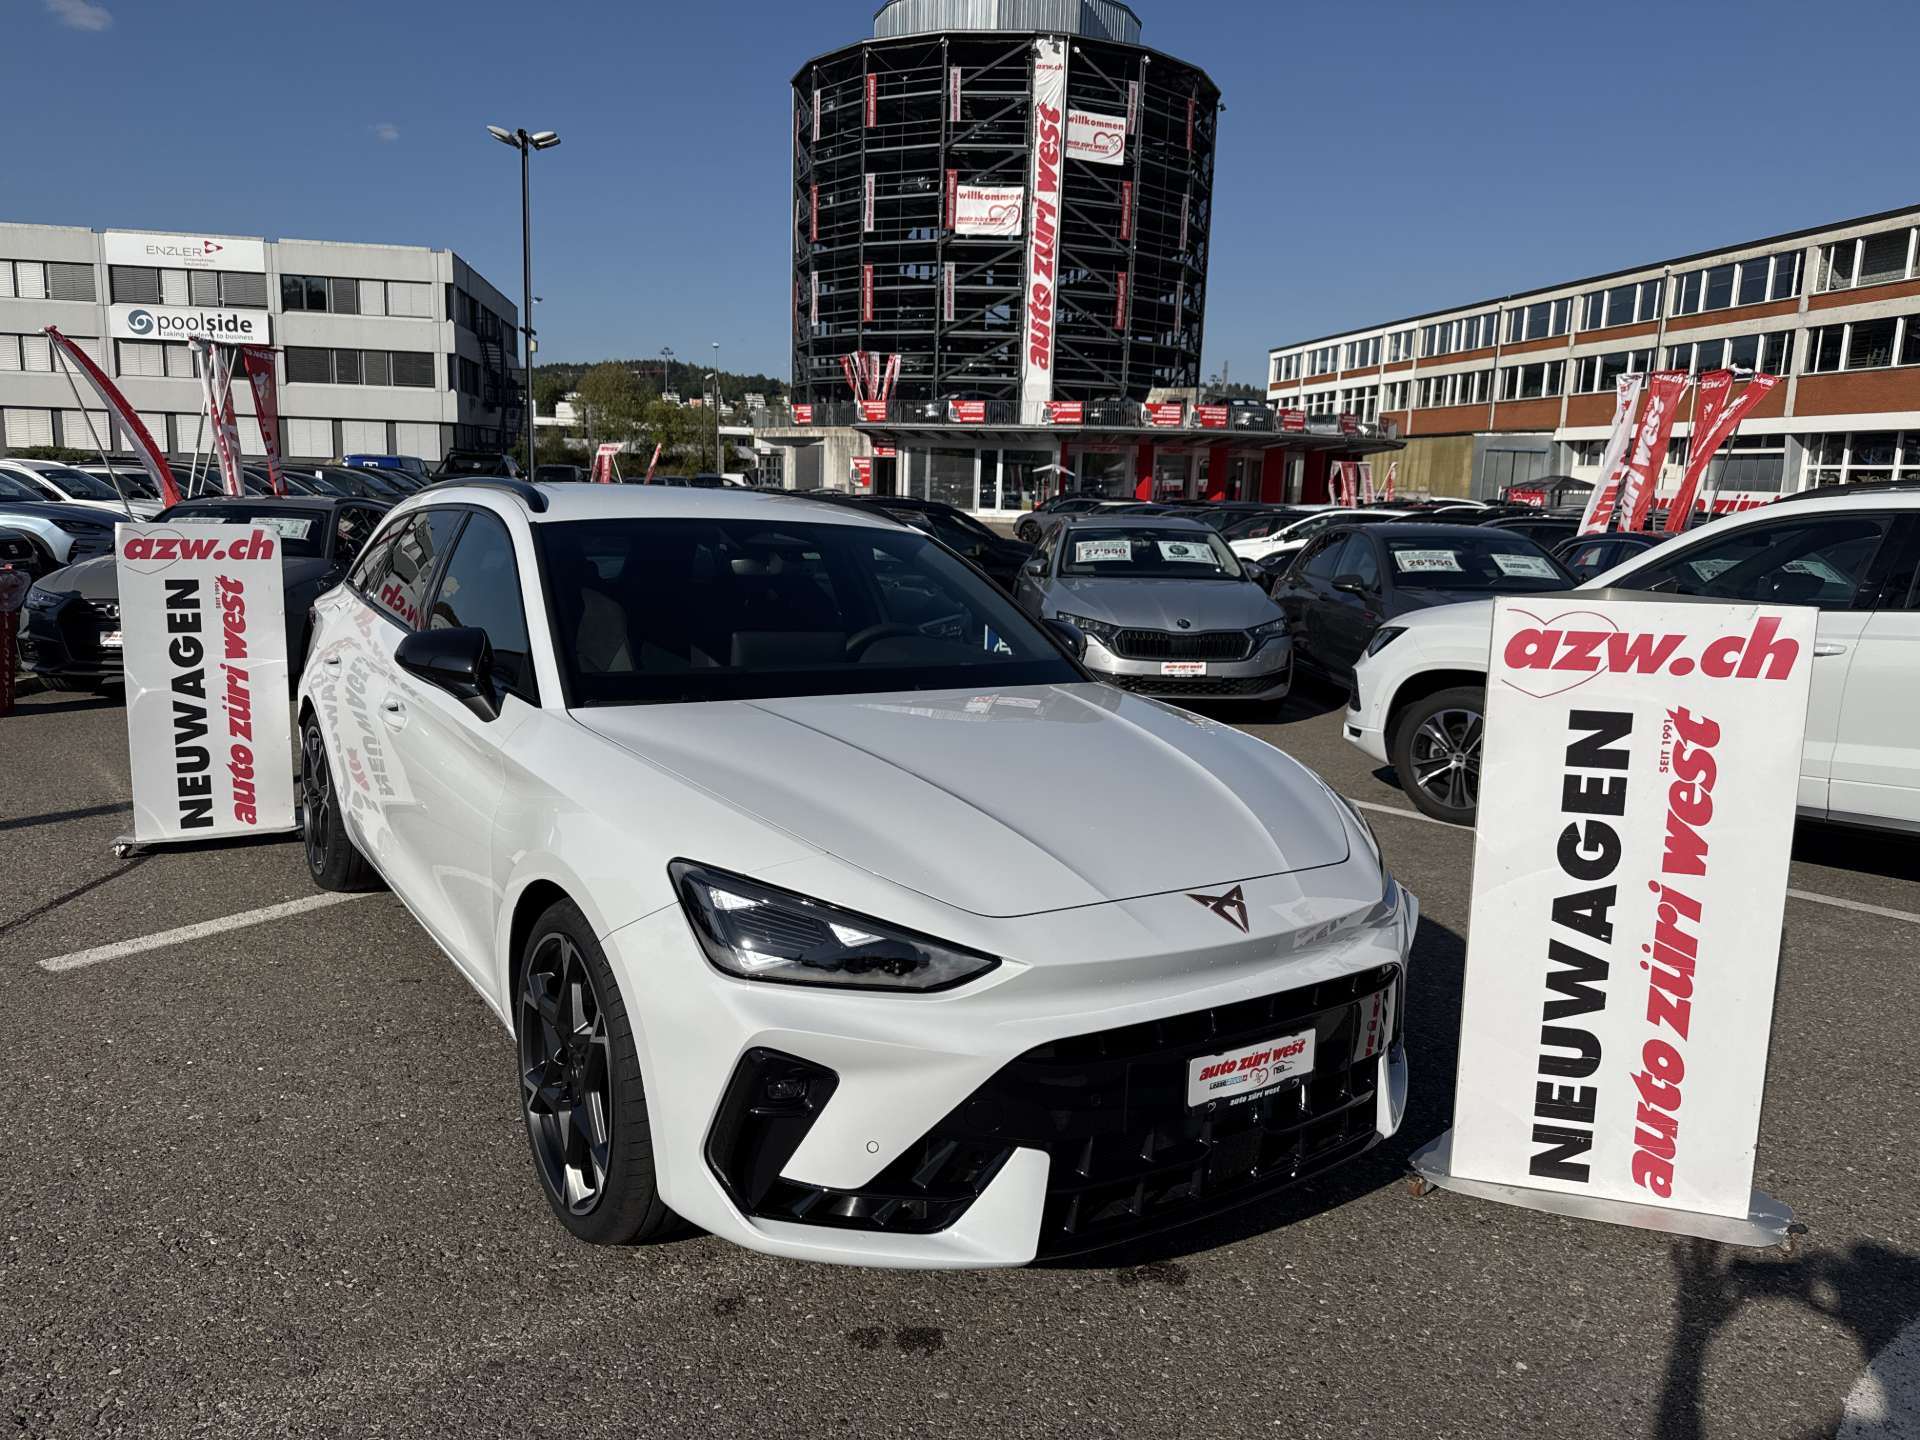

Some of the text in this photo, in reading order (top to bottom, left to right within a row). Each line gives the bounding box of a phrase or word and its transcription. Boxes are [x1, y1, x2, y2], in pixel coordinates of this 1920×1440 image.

[1067, 114, 1124, 130] willkommen
[958, 190, 1021, 201] willkommen
[146, 245, 202, 257] ENZLER
[1028, 102, 1061, 370] auto züri west
[157, 312, 253, 336] poolside
[186, 332, 215, 341] studen
[225, 333, 254, 341] business
[124, 530, 273, 561] azw.ch
[1503, 616, 1800, 681] azw.ch
[164, 579, 214, 829] NEUWAGEN
[216, 575, 257, 825] auto züri west
[1659, 718, 1674, 773] SEIT 1991
[1529, 709, 1634, 1183] NEUWAGEN
[1631, 705, 1721, 1198] auto züri west
[1199, 1038, 1306, 1081] auto züri west
[1229, 1085, 1281, 1106] auto züri west
